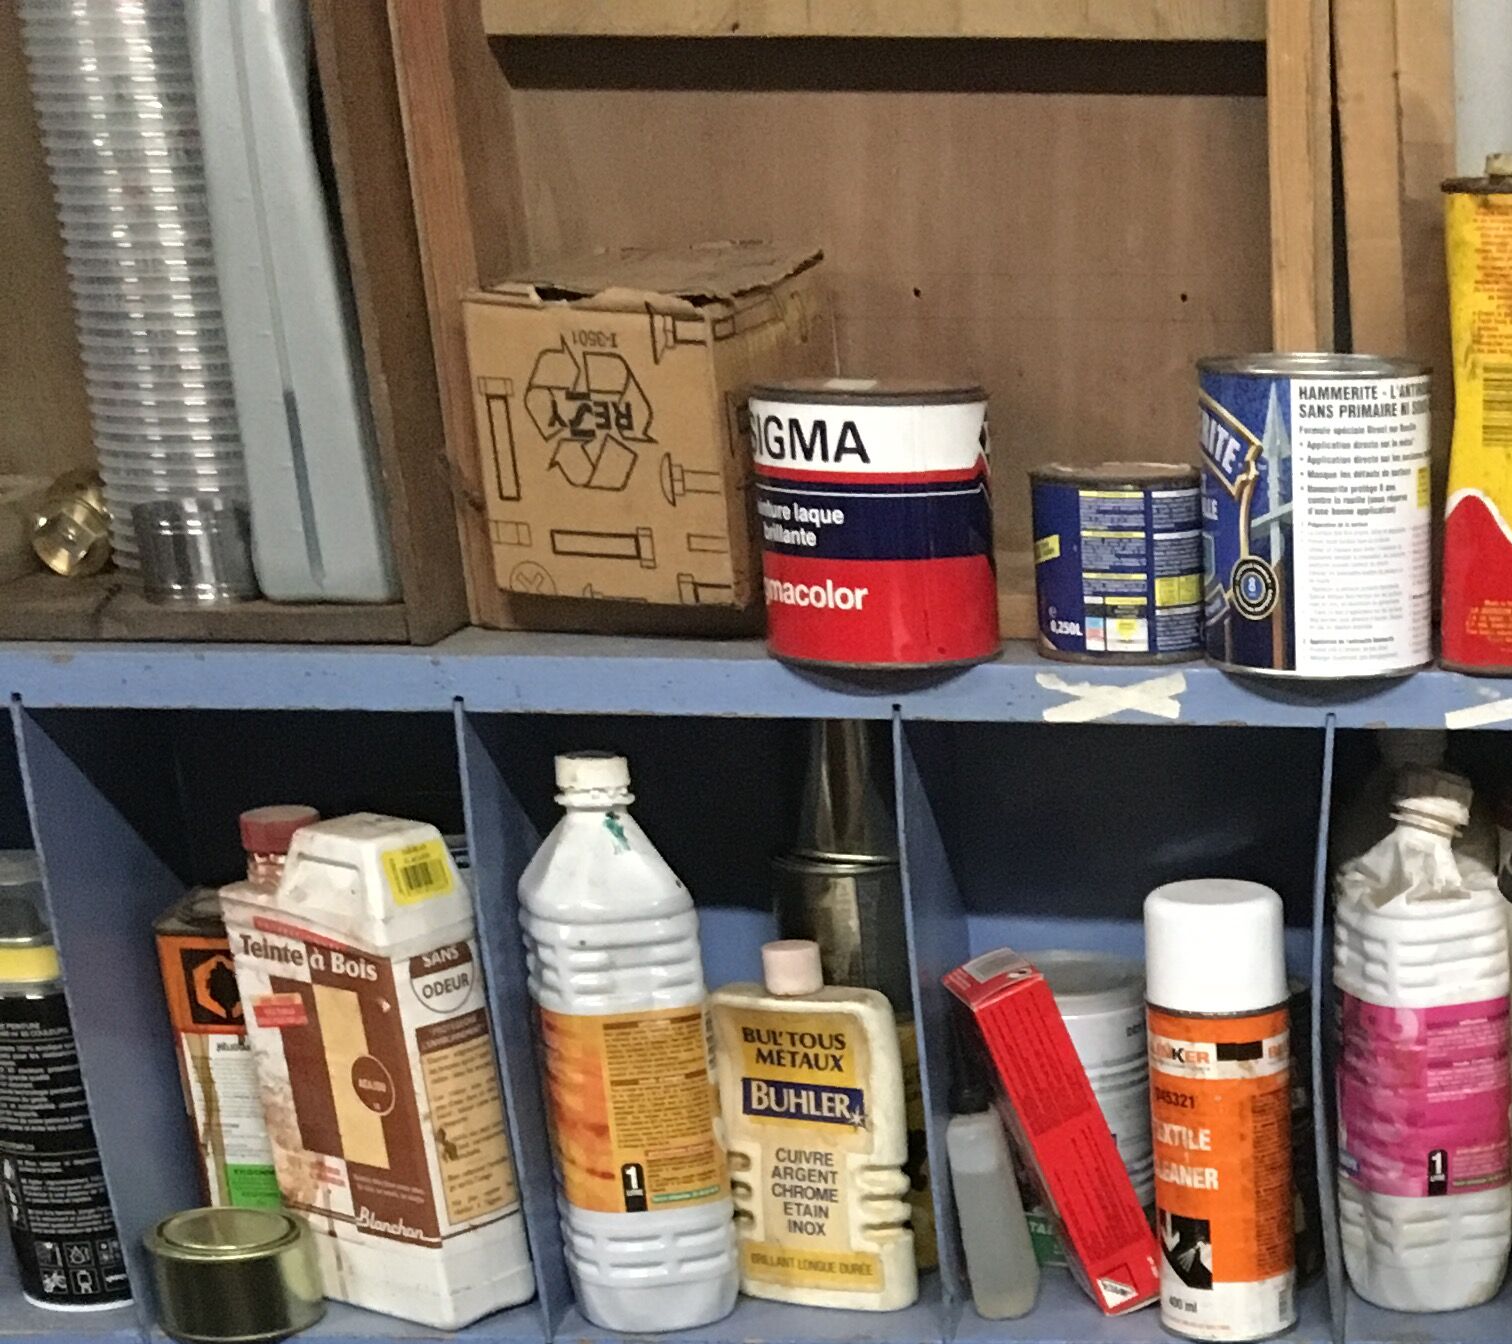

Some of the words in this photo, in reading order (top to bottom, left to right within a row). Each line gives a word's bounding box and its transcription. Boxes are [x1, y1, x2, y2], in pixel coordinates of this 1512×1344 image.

[1299, 385, 1378, 401] HAMMERITE
[1299, 404, 1334, 418] SANS
[1339, 403, 1398, 418] PRIMAIRE
[794, 502, 844, 528] laque
[239, 933, 305, 967] Teinte
[309, 946, 325, 970] à
[330, 951, 379, 982] Bois
[420, 946, 460, 969] SANS
[421, 972, 470, 1000] ODEUR
[786, 1031, 846, 1051] TOUS
[750, 1080, 852, 1120] BUHLER
[1155, 1120, 1212, 1152] EXTILE
[775, 1147, 835, 1167] CUIVRE
[1430, 1151, 1445, 1175] 1
[624, 1165, 639, 1190] 1
[771, 1165, 839, 1185] ARGENT
[771, 1182, 840, 1204] CHROME
[783, 1201, 830, 1220] ETAIN
[787, 1219, 827, 1237] INOX
[751, 1252, 795, 1269] BRILLANT
[797, 1257, 838, 1274] LONGUE
[1185, 1299, 1198, 1313] ml
